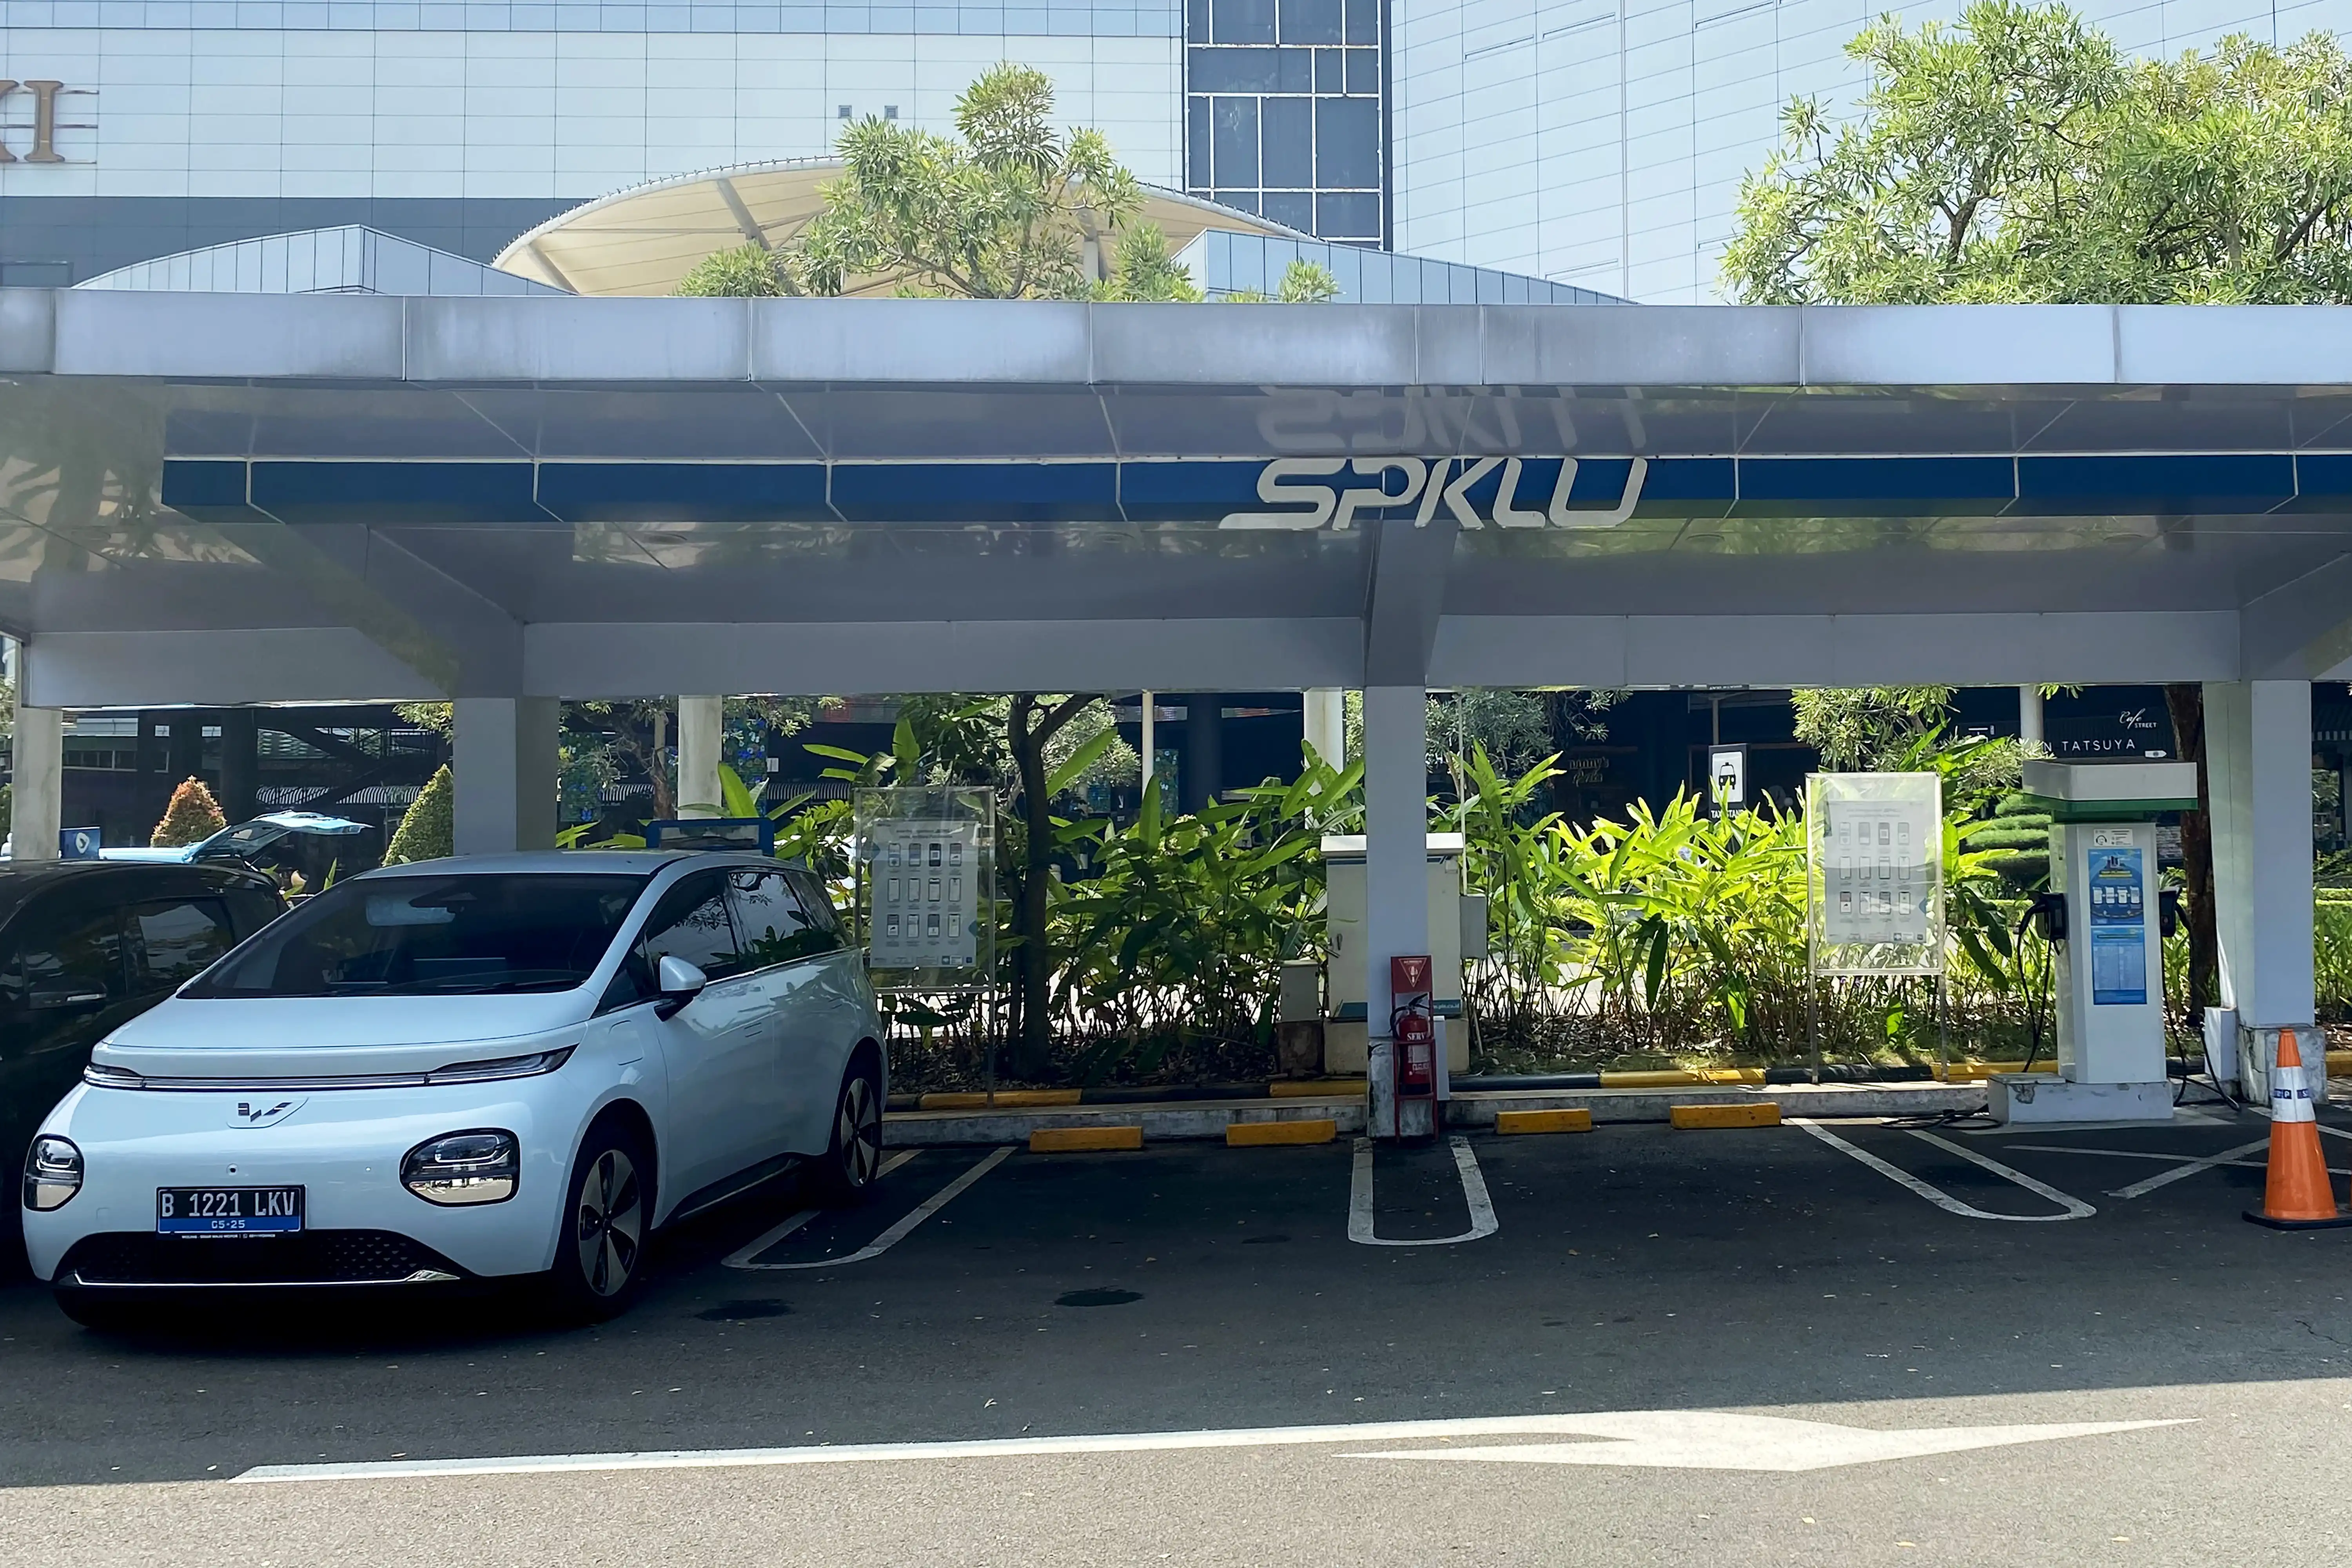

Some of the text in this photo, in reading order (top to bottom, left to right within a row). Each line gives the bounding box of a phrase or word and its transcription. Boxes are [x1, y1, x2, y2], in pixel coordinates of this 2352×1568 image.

[1218, 456, 1648, 530] SPKLU
[2062, 739, 2136, 751] TATSUYA
[162, 1192, 295, 1217] B 1221 LKV
